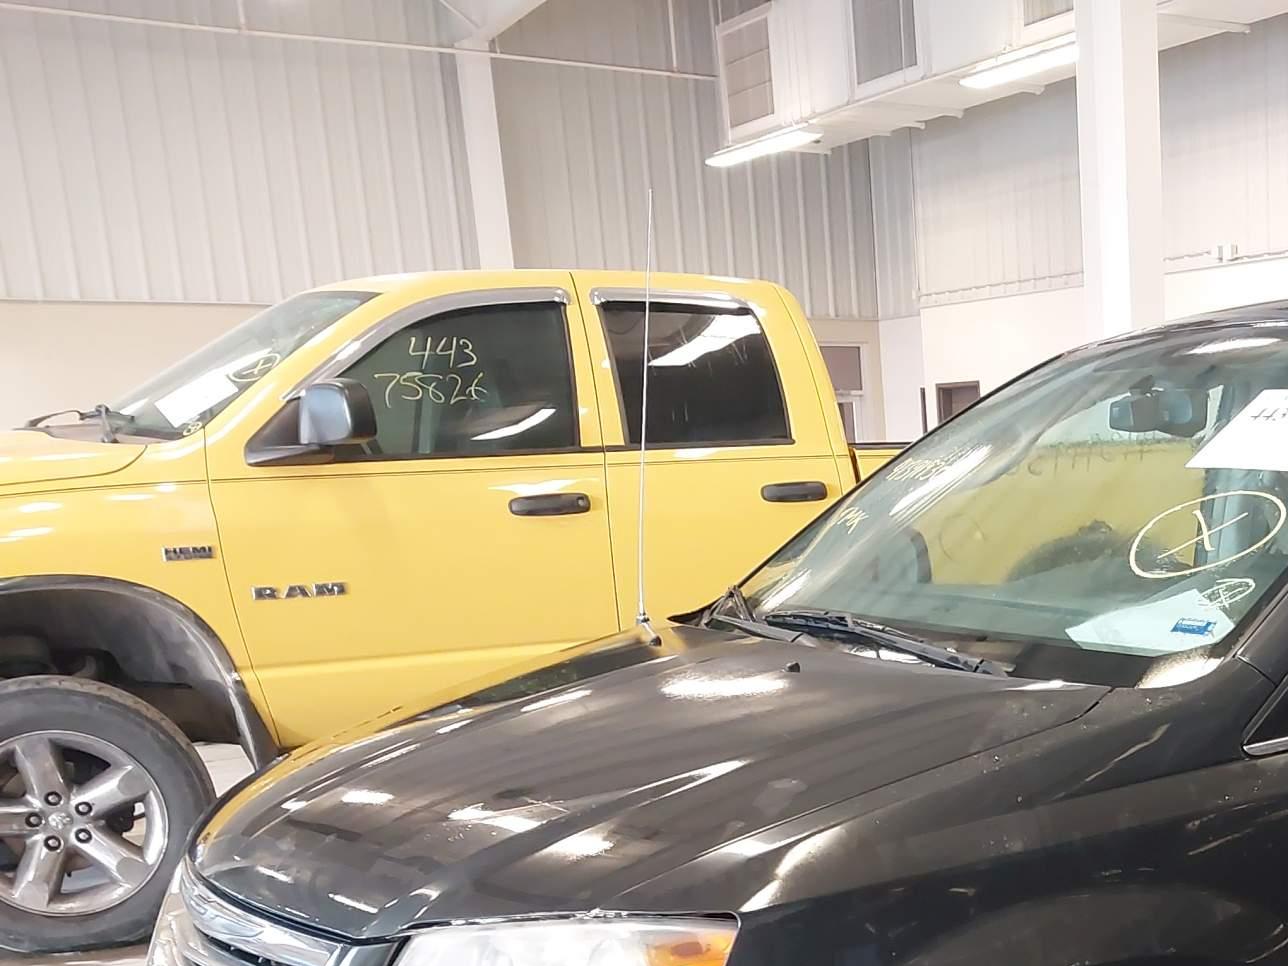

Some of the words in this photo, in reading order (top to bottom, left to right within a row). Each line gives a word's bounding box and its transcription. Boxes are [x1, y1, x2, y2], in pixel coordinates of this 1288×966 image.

[408, 336, 477, 370] 443
[164, 546, 213, 557] HEMI
[252, 582, 346, 600] RAM
